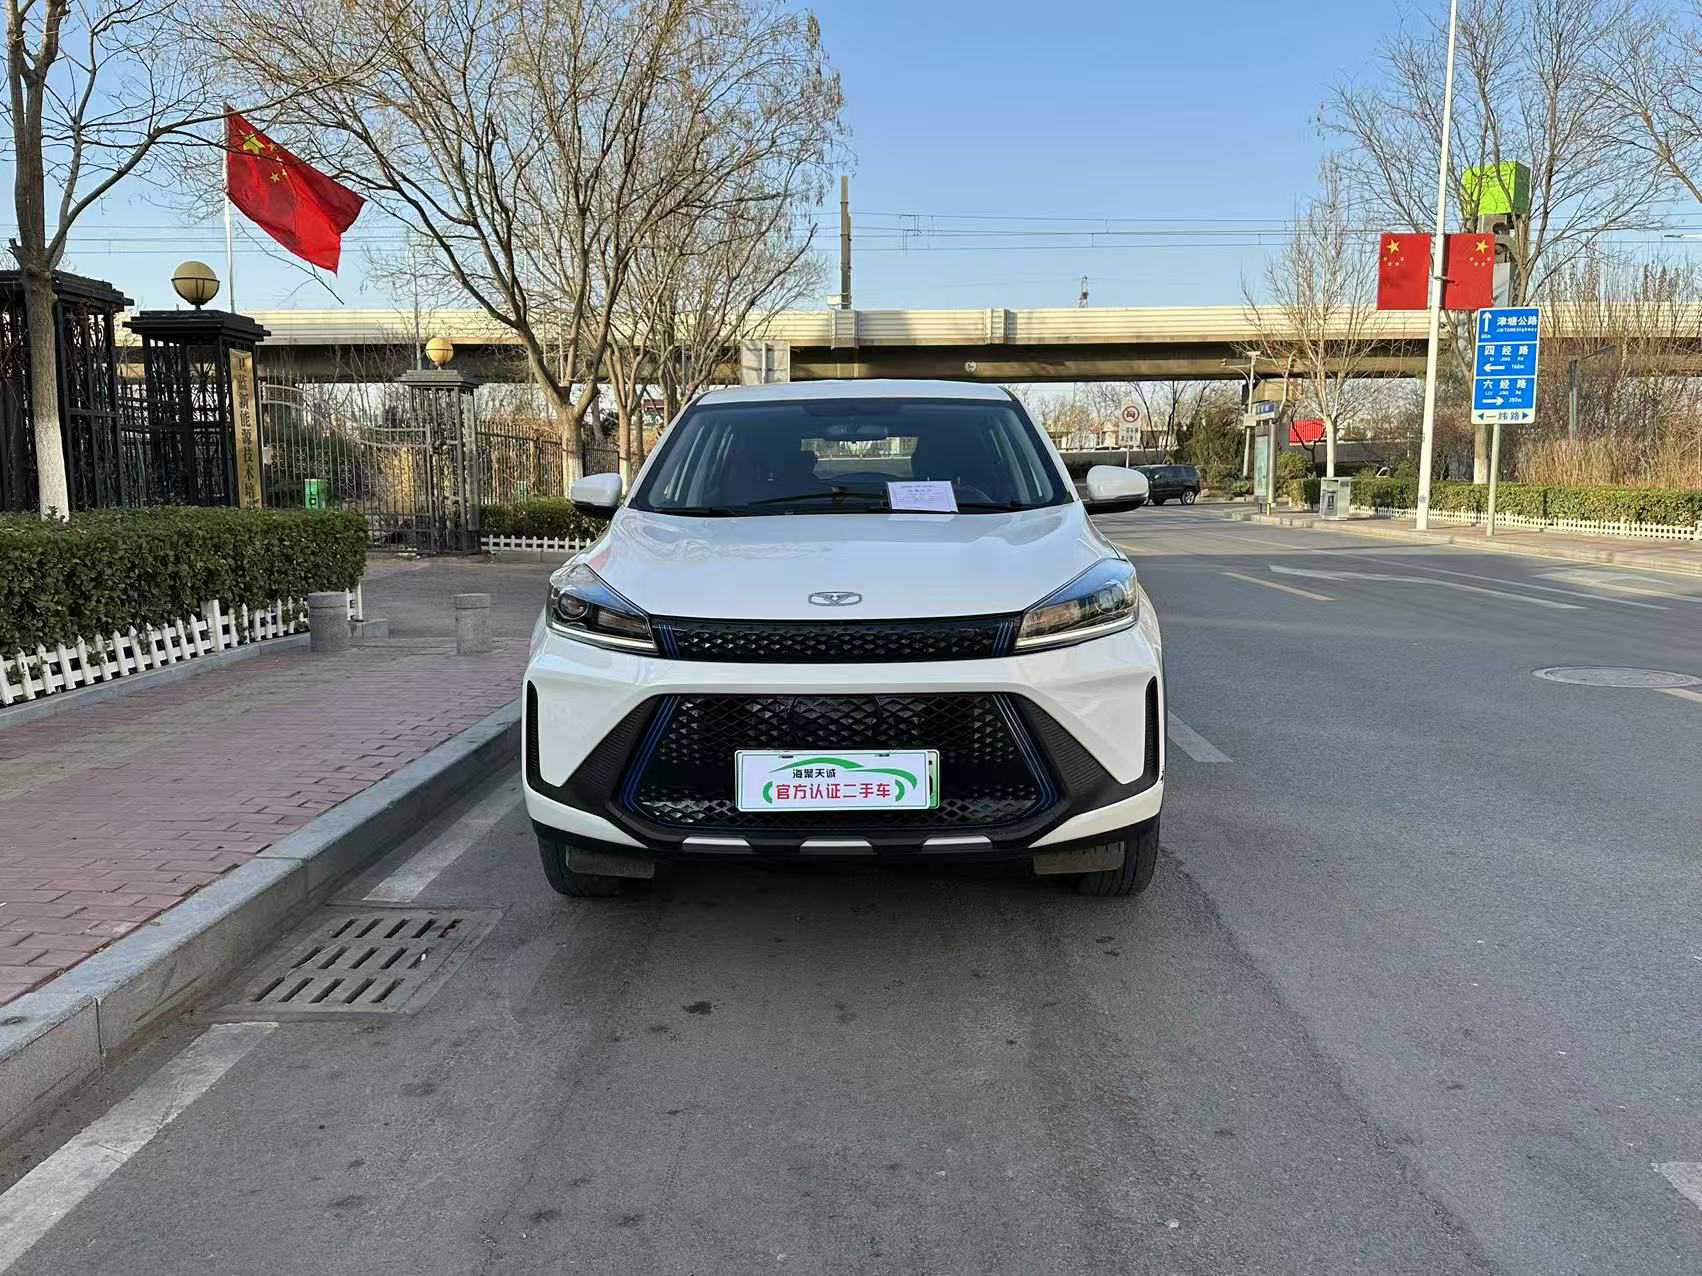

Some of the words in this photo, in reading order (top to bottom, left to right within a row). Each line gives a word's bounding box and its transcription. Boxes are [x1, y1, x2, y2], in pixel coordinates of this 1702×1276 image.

[1484, 345, 1529, 356] 四经路
[1483, 379, 1527, 390] 六经路
[1486, 411, 1520, 421] 一纬路
[792, 768, 837, 779] 海聚天诚
[776, 783, 891, 800] 官方认证二手车
